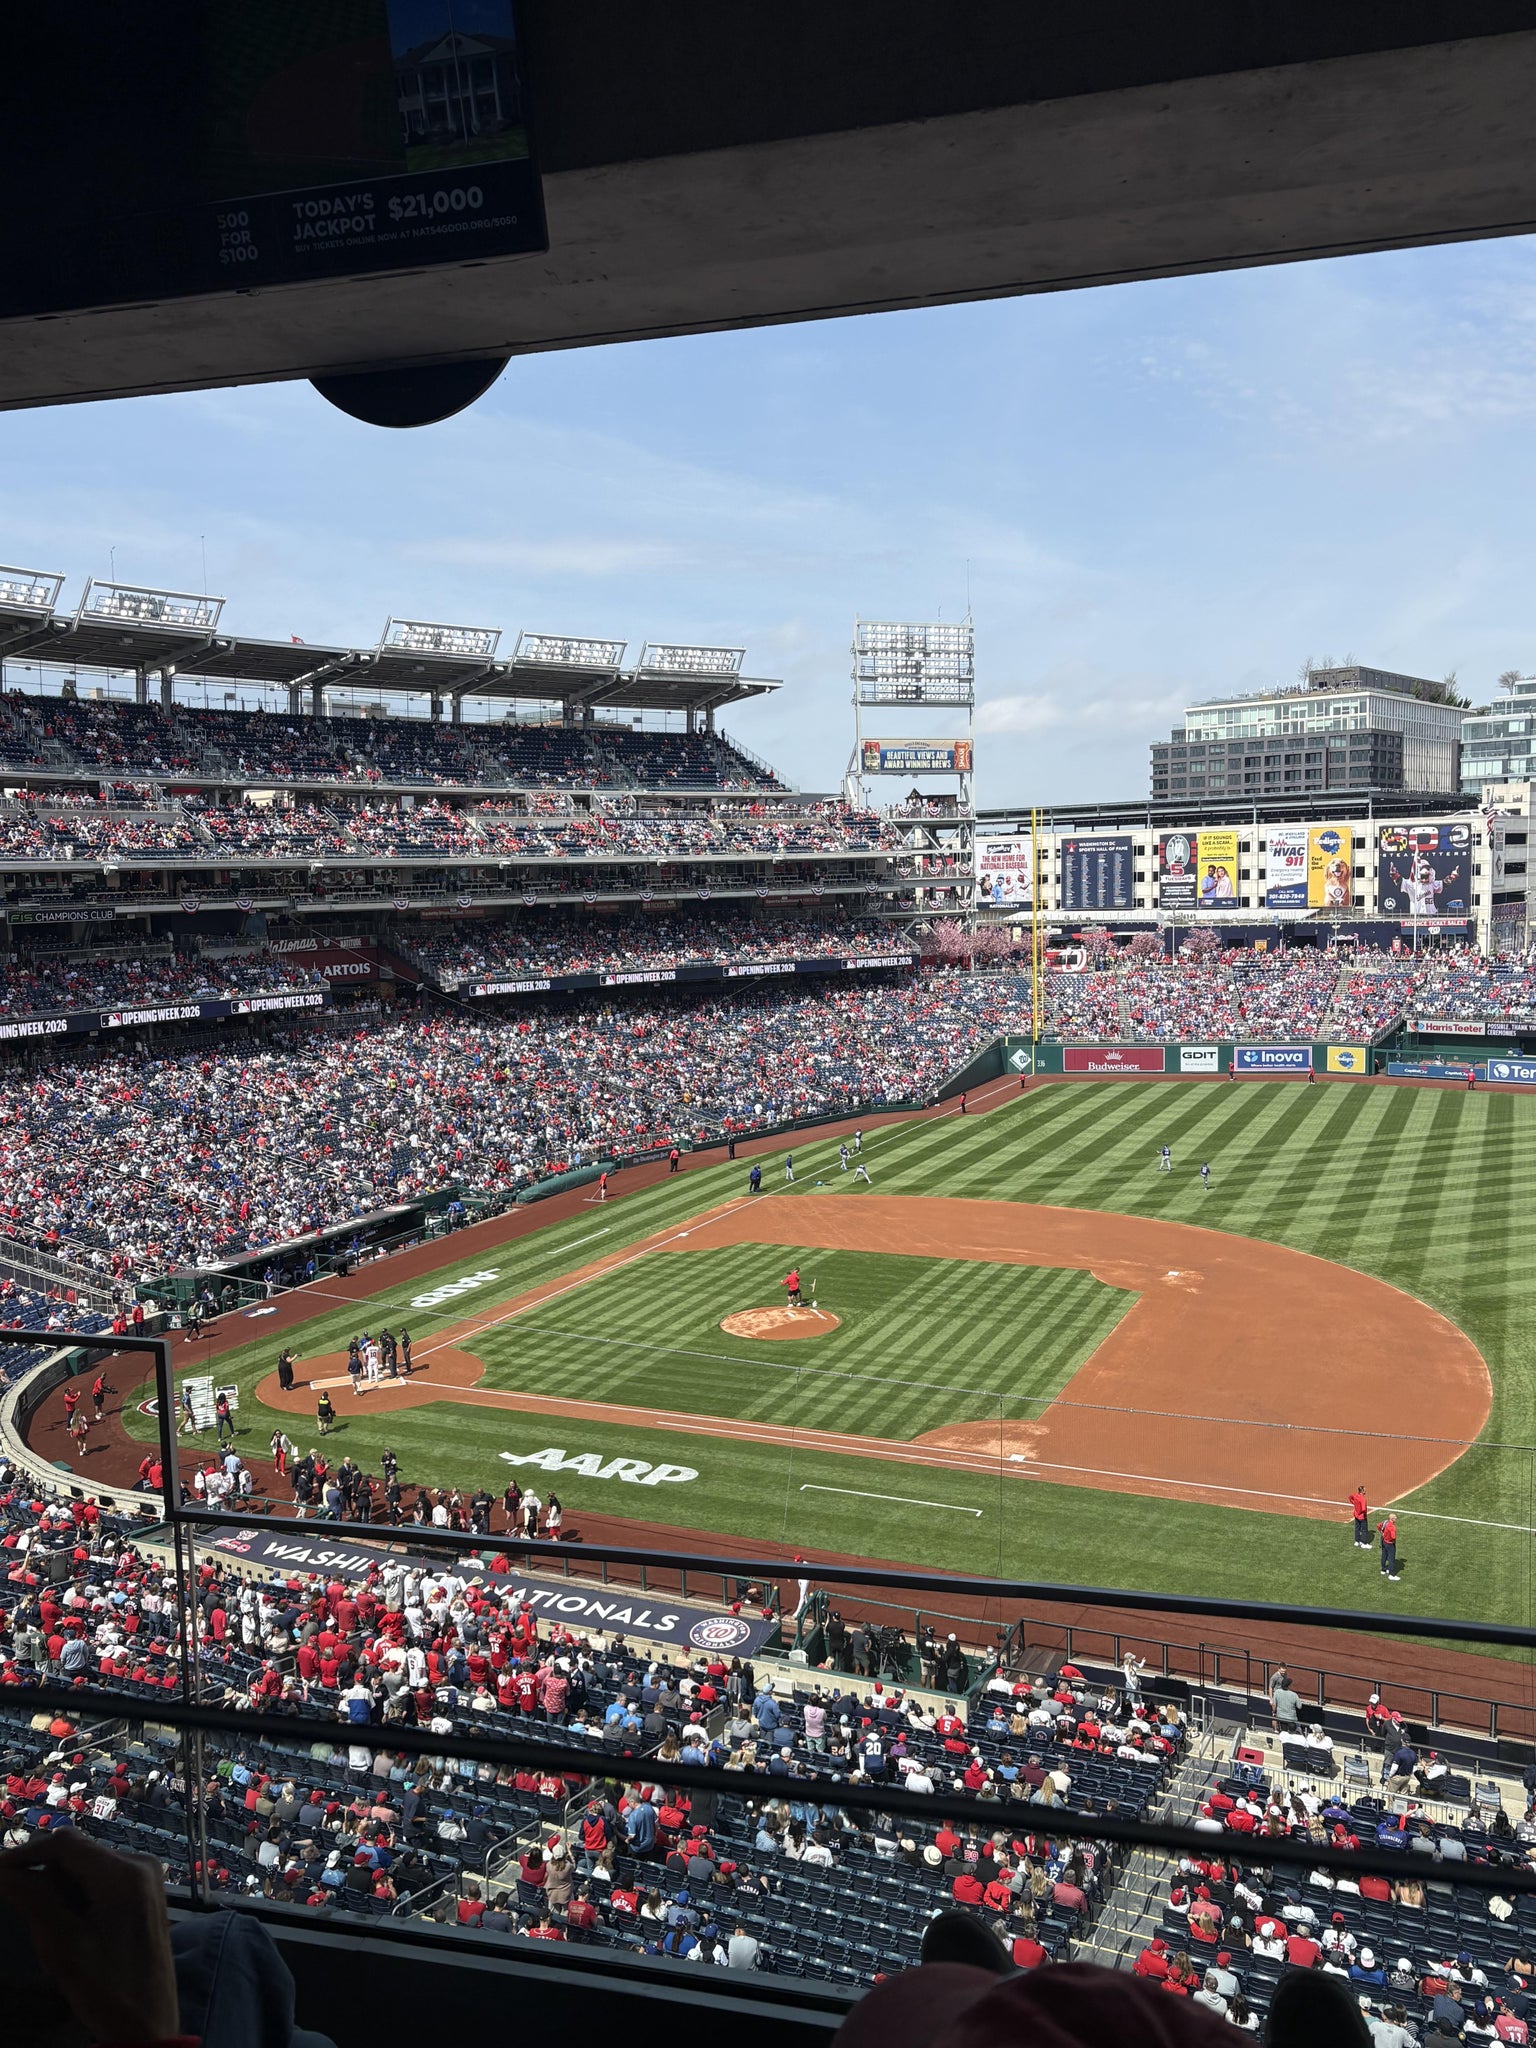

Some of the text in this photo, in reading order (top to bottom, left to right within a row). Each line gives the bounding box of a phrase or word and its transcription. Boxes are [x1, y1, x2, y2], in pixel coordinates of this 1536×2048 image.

[292, 187, 484, 221] TODAY'S $21,000
[217, 211, 248, 229] 500
[294, 213, 376, 241] JACKPOT
[313, 239, 345, 250] TICKETS
[346, 235, 375, 247] ONLINE
[377, 232, 398, 243] NOW
[399, 230, 411, 240] AT
[412, 215, 518, 237] NATS4GOOD.ORG/5050
[220, 232, 251, 246] FOR
[219, 246, 258, 265] $100
[887, 751, 916, 760] BEAUTIFUL
[917, 751, 935, 760] VIEWS
[936, 751, 948, 759] AND
[884, 760, 952, 769] AWARD WINNING BREWS
[1273, 846, 1306, 857] HVAC
[982, 855, 991, 863] THE
[1002, 854, 1016, 862] HOME
[1016, 854, 1026, 862] FOR
[1285, 856, 1304, 866] 911
[1006, 862, 1028, 870] BASEBALL
[10, 910, 113, 922] FIS CHAMPIONS CLUB
[856, 956, 912, 968] OPENING WEEK 2026
[323, 962, 371, 977] ARTOIS
[738, 963, 796, 976] OPENING WEEK 2026
[616, 971, 676, 985] OPENING WEEK 2026
[487, 979, 551, 995] OPENING WEEK 2026
[251, 993, 323, 1012] OPENING WEEK 2026
[122, 1005, 201, 1025] OPENING WEEK 2026
[18, 1022, 45, 1037] WEEK
[45, 1019, 68, 1033] 2026
[1426, 1022, 1483, 1033] Harris Teeter
[1182, 1051, 1217, 1059] GDIT
[1261, 1051, 1303, 1063] Inova
[1037, 1060, 1046, 1068] 336
[1088, 1061, 1139, 1071] Budweiser
[498, 1448, 699, 1486] AARP
[701, 1619, 747, 1635] WASHINGTON
[491, 1642, 500, 1654] 16
[520, 1684, 532, 1695] 31
[944, 1721, 952, 1732] 5
[831, 1745, 845, 1756] 24
[865, 1741, 882, 1755] 20
[94, 1804, 106, 1816] 31
[964, 1849, 979, 1863] 29
